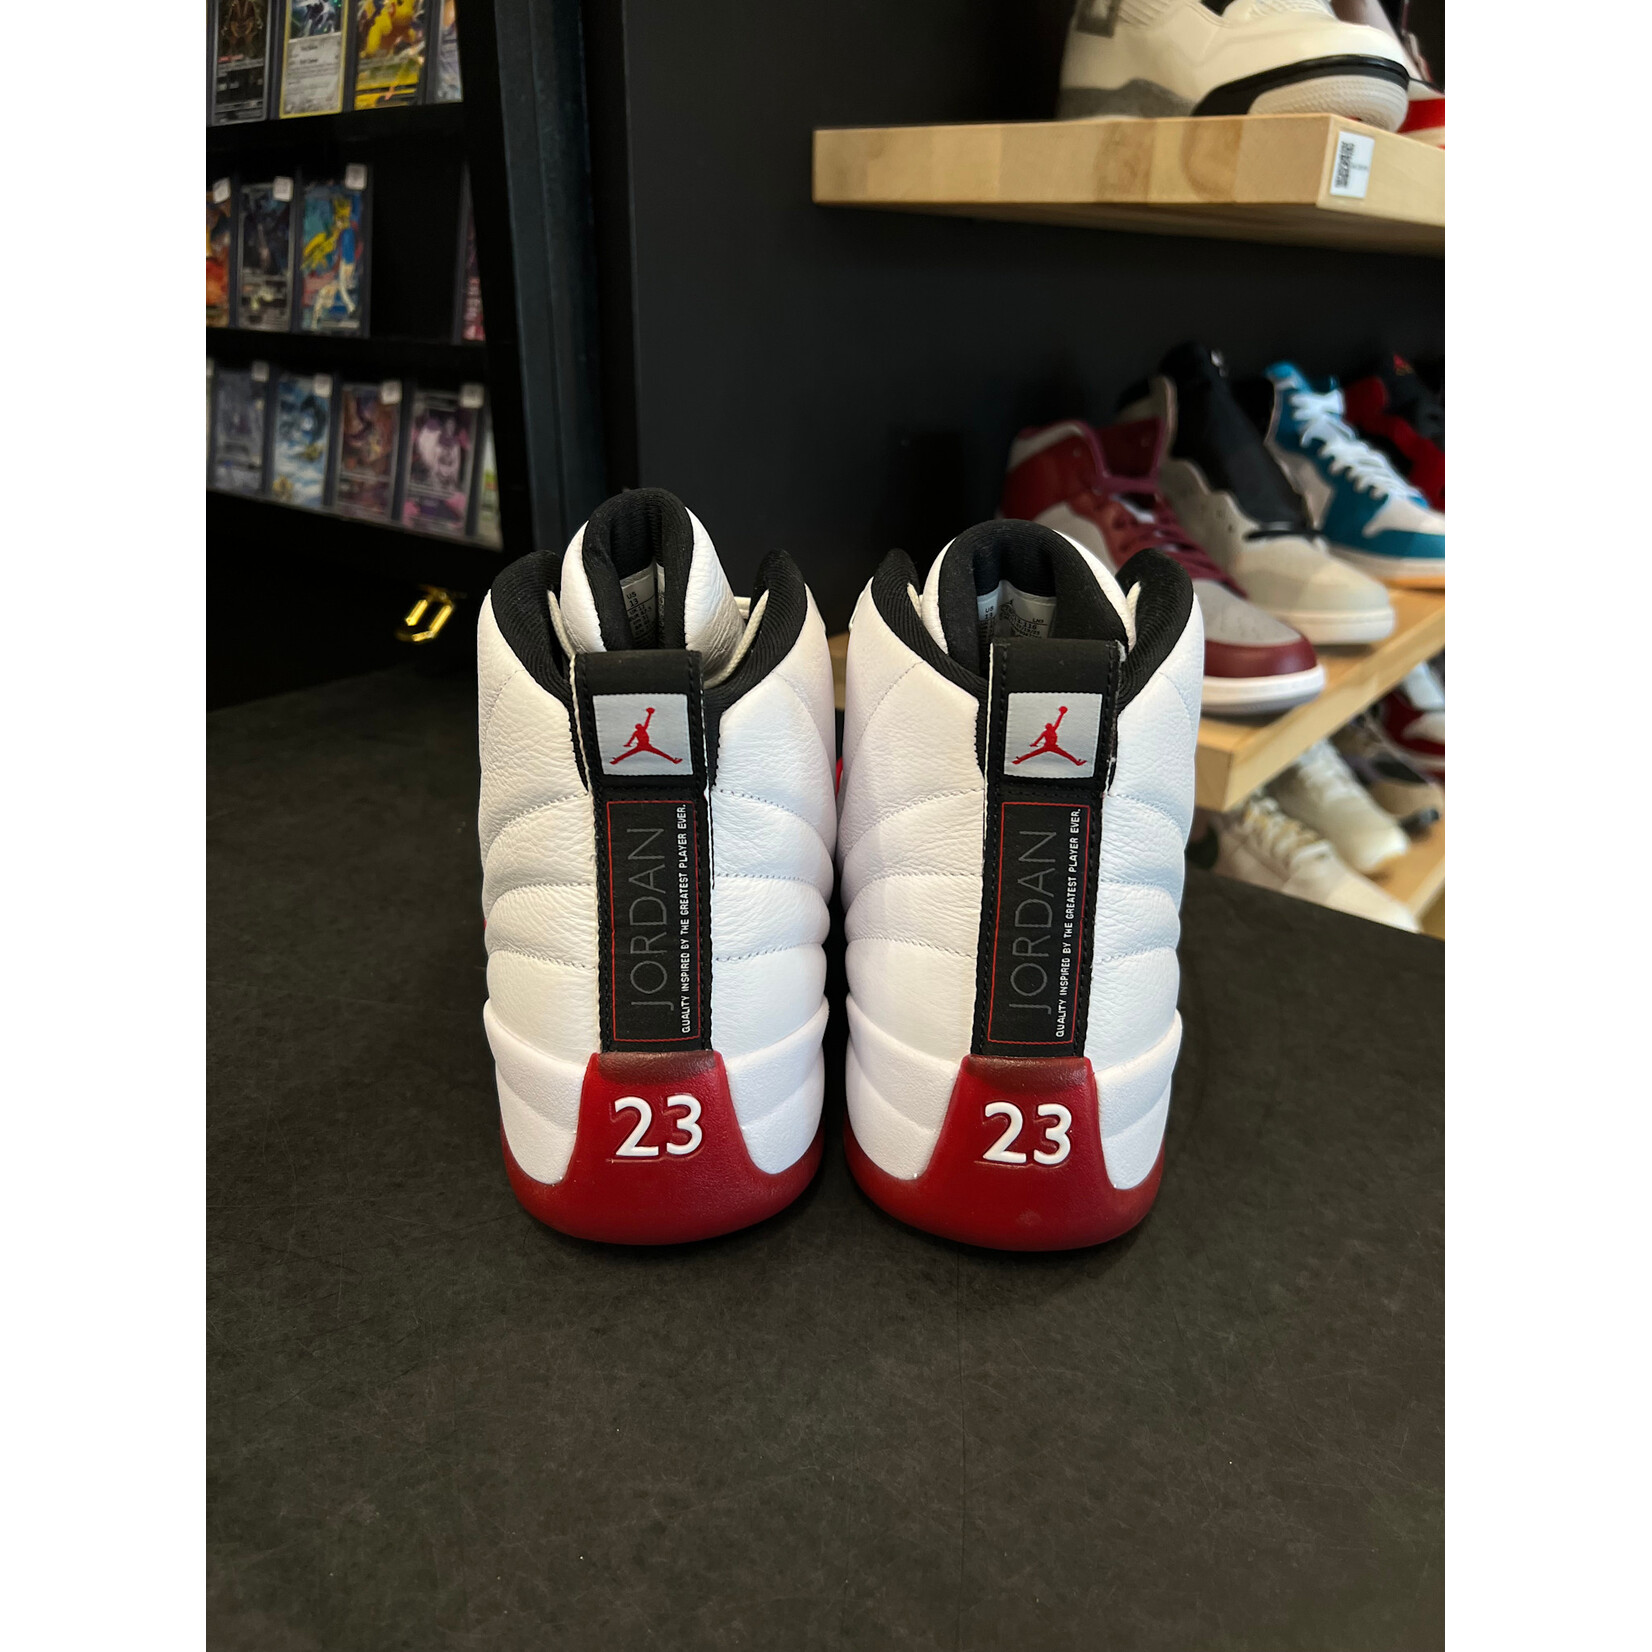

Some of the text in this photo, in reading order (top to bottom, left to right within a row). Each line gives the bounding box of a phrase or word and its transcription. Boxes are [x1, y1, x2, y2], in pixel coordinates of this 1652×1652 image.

[626, 828, 675, 1012] JORDAN
[676, 804, 691, 1034] QUALITY INSPIRED BY THE GREATEST PLAYER EVER.
[1008, 830, 1057, 1015] JORDAN
[1055, 808, 1081, 1038] QUALITY INSPIRED BY THE GREATEST PLAYER EVER.
[614, 1094, 703, 1157] 23
[982, 1101, 1072, 1166] 23
